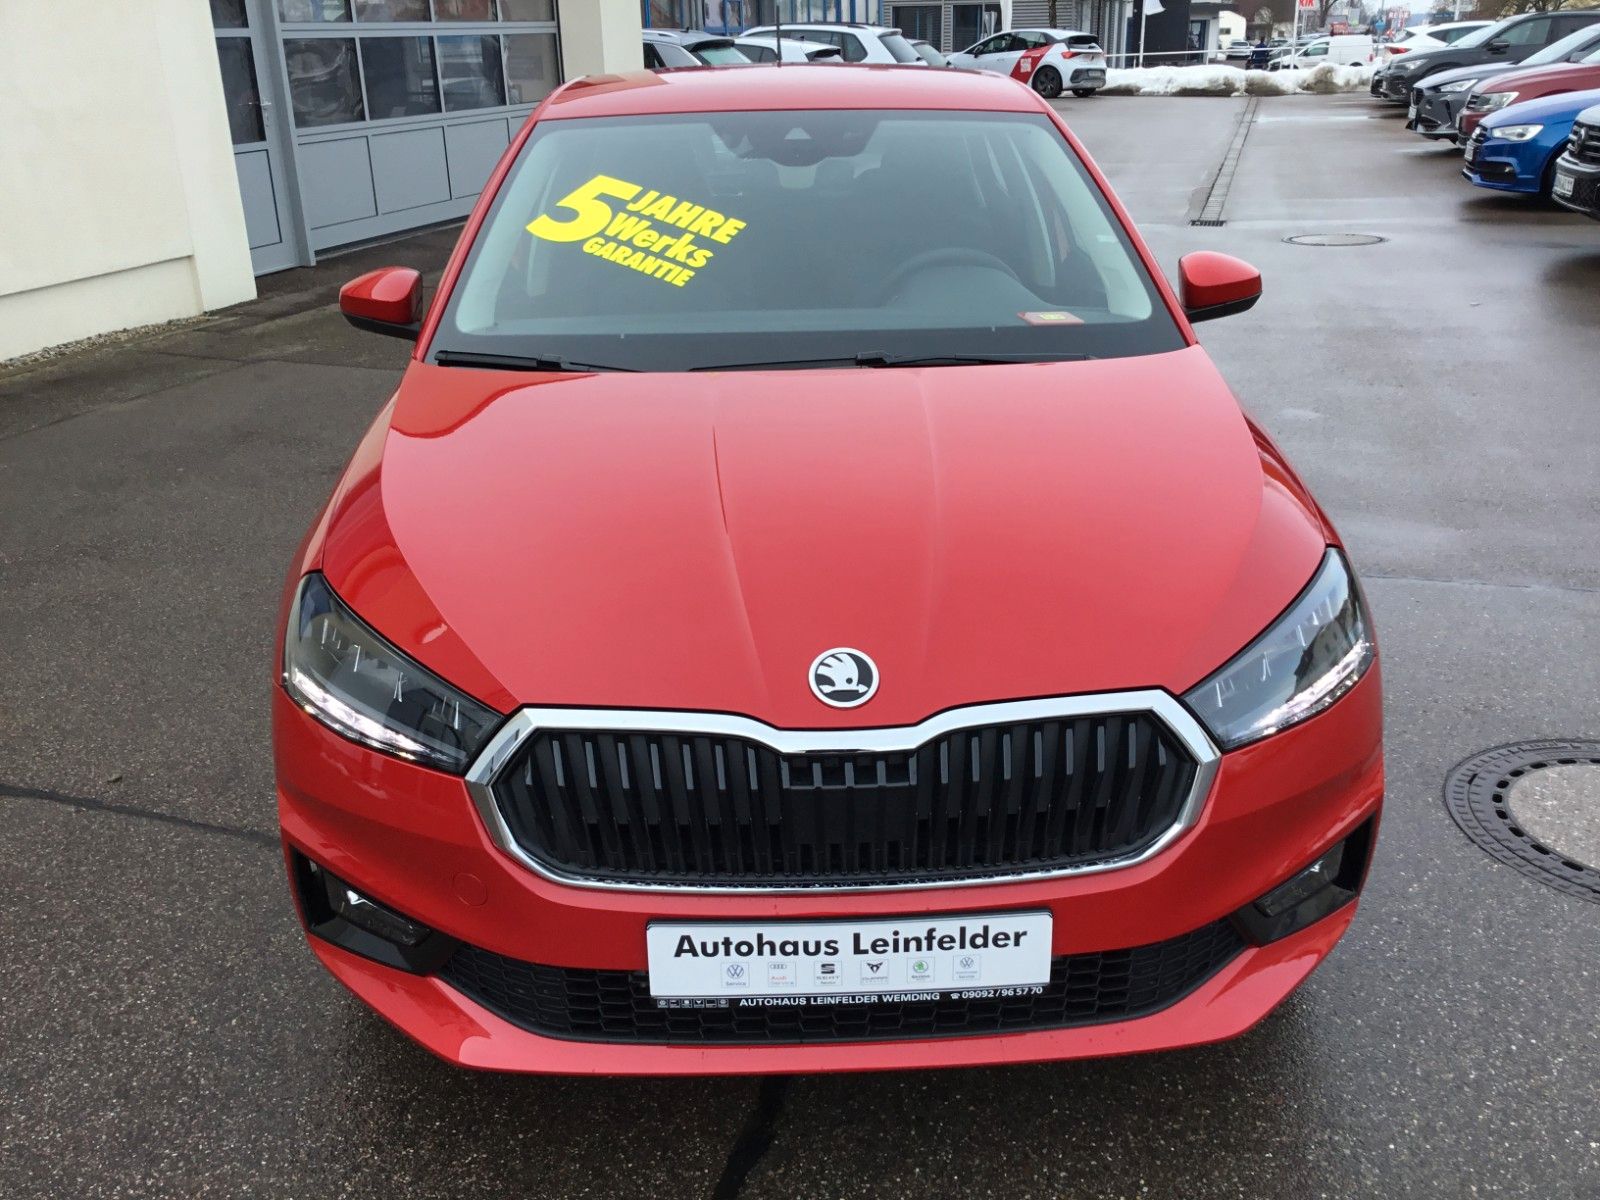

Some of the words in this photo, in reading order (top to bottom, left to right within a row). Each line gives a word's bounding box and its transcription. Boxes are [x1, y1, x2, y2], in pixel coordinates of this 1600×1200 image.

[525, 174, 643, 242] 5
[626, 190, 747, 244] JAHRE
[582, 237, 695, 287] GARANTIE
[604, 212, 714, 267] Werks
[673, 932, 840, 958] Autohaus
[853, 925, 1028, 955] Leinfelder
[739, 997, 807, 1007] AUTOHAUS
[810, 995, 878, 1005] LEINFELDER
[882, 992, 940, 1003] WEMDING
